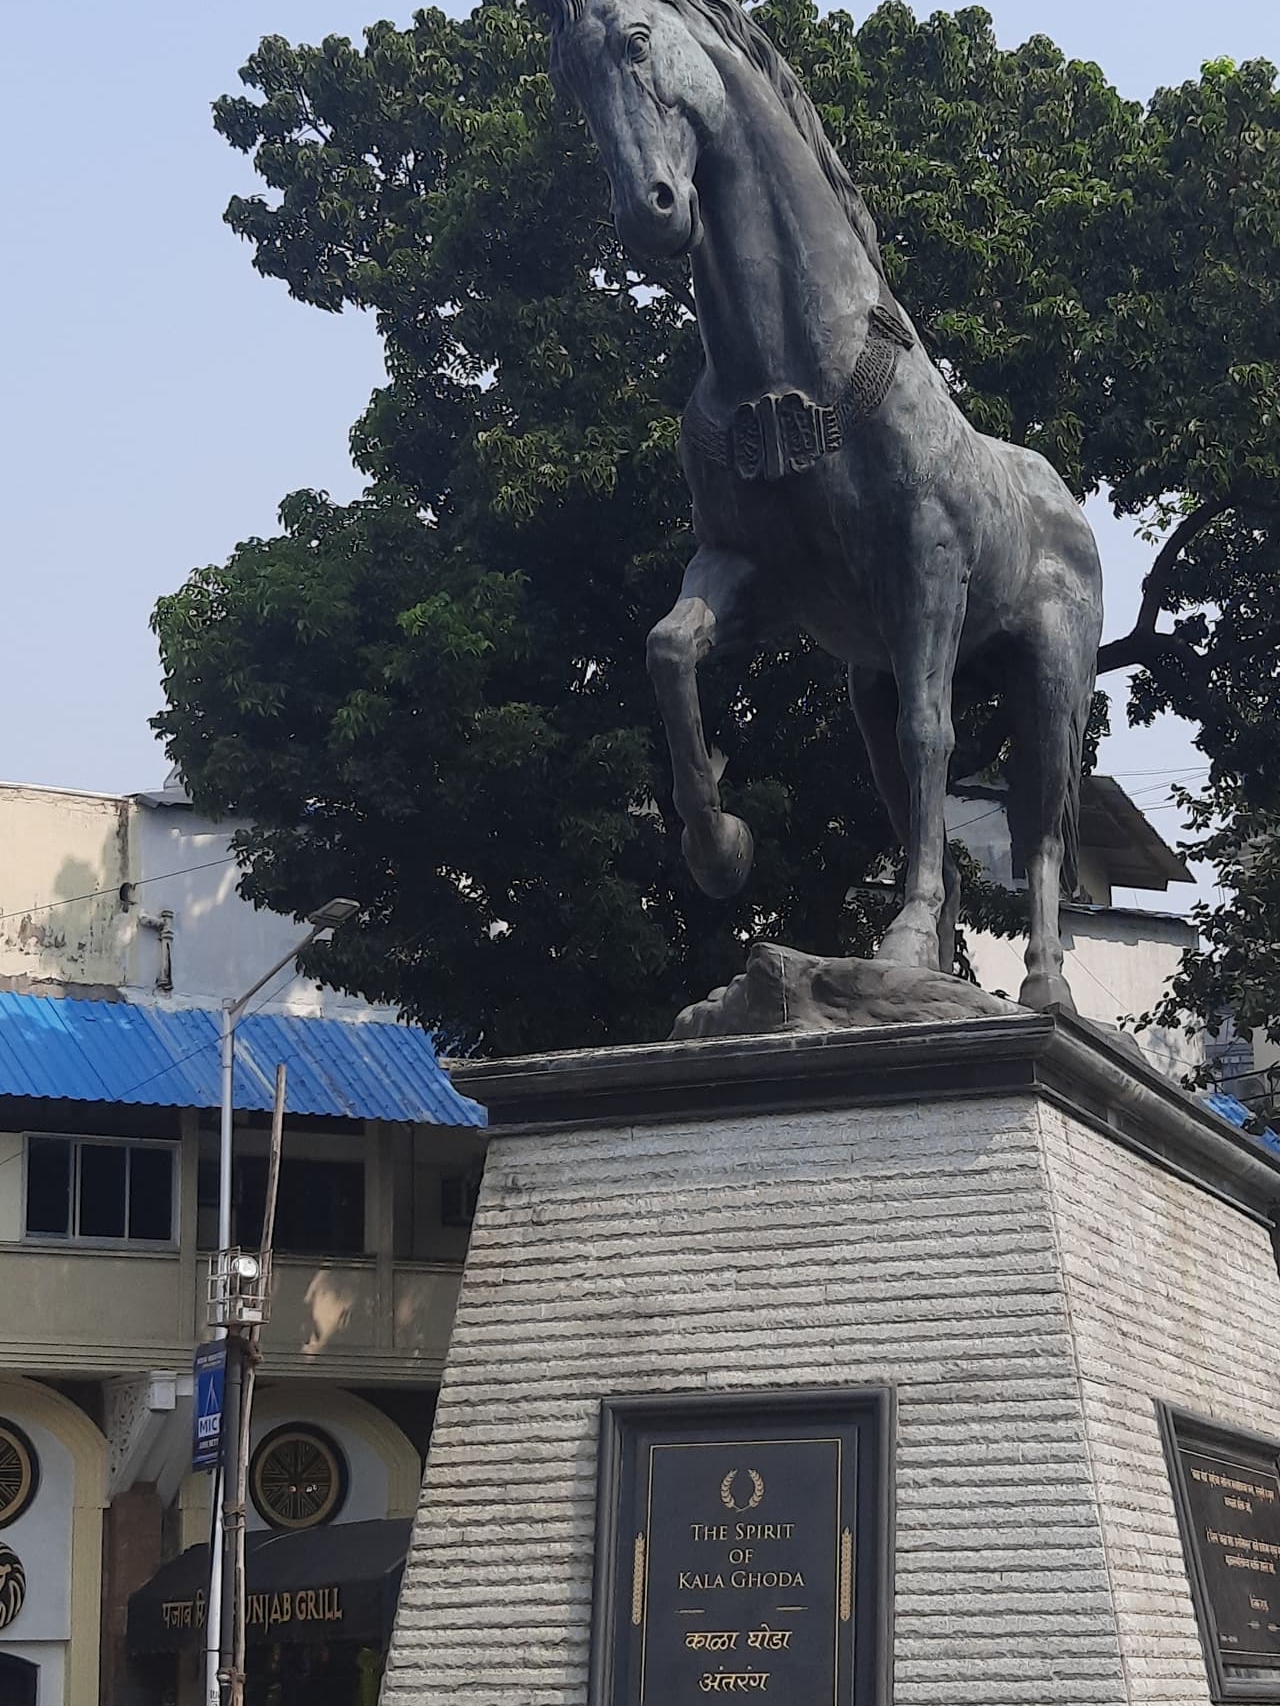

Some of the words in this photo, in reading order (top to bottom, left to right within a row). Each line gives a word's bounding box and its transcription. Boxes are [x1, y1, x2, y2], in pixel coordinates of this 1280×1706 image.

[200, 1417, 218, 1434] MIC
[691, 1524, 728, 1541] THE
[735, 1522, 796, 1541] SPIRIT
[728, 1548, 754, 1565] OF
[678, 1572, 726, 1590] KALA
[730, 1570, 806, 1589] GHODA
[245, 1591, 292, 1634] UNJAB
[295, 1587, 343, 1622] GRILL
[685, 1631, 740, 1651] काळा
[746, 1623, 793, 1650] घोडा
[699, 1665, 771, 1693] अंतरंग
